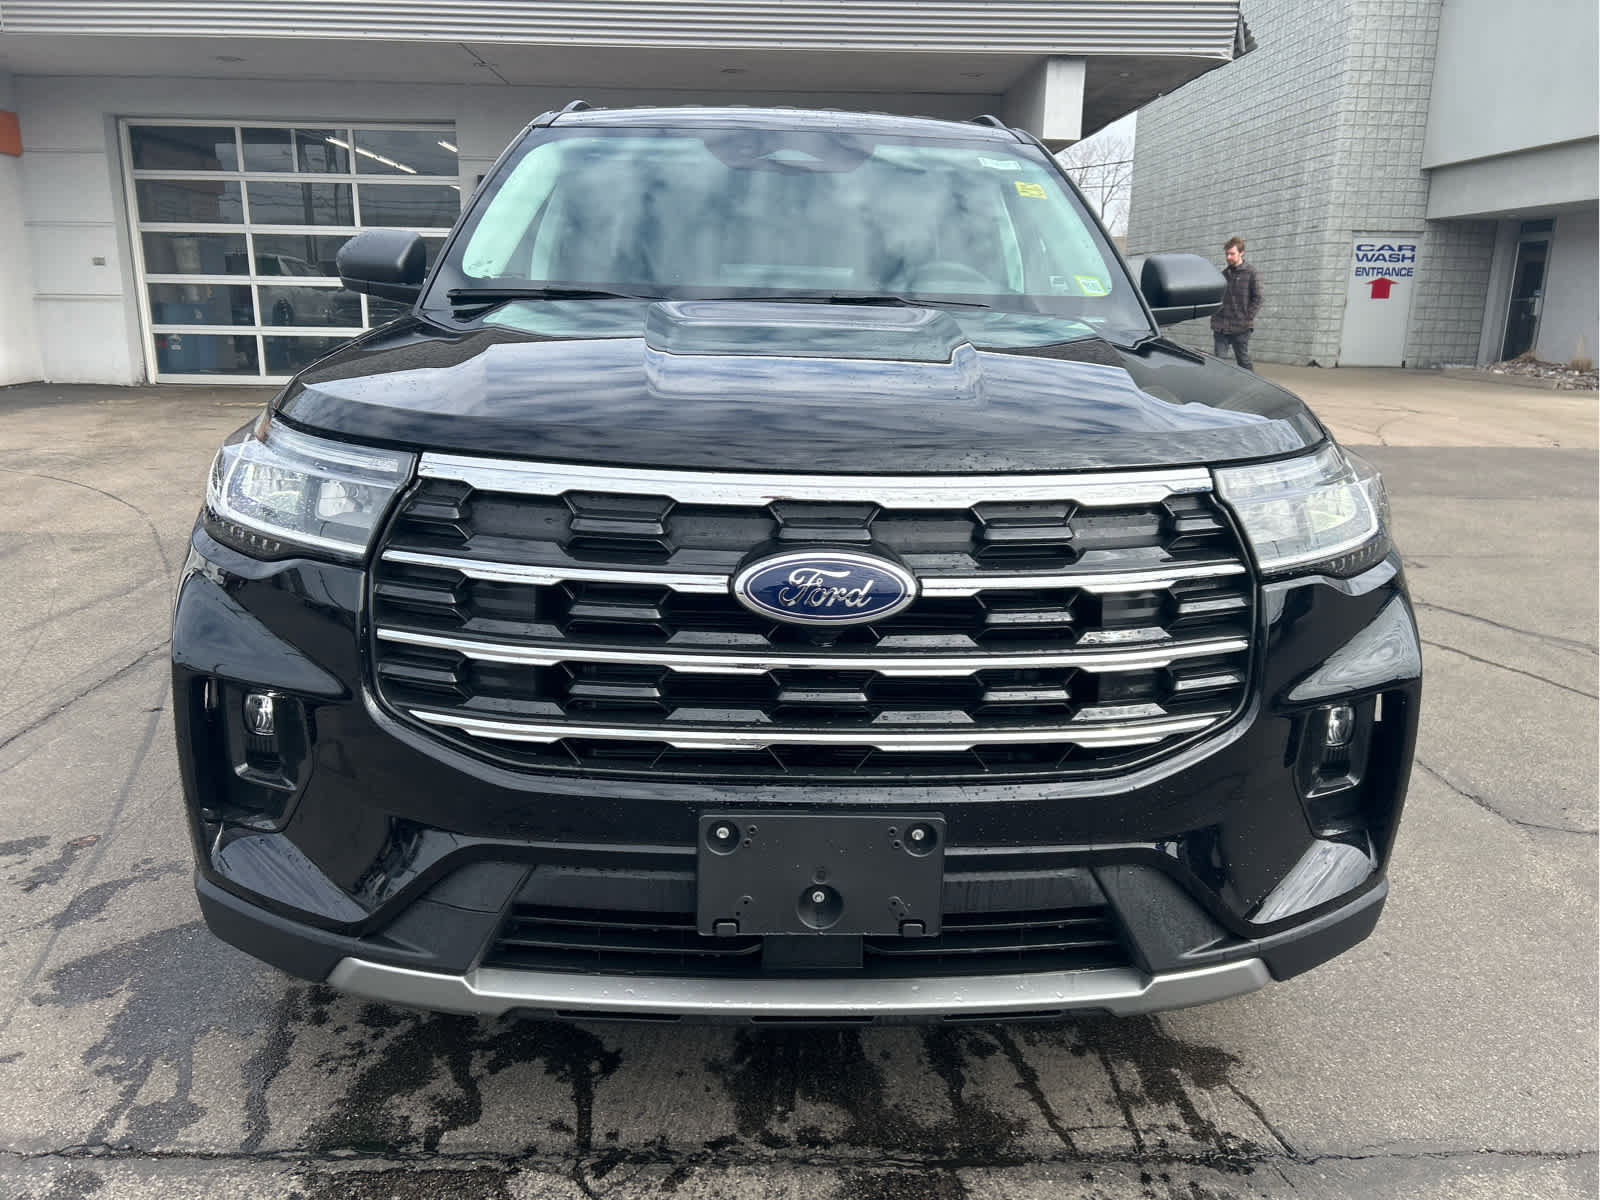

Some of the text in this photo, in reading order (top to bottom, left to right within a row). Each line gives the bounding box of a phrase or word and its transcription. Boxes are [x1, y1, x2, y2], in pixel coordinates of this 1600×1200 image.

[1356, 244, 1416, 252] CAR
[1355, 253, 1415, 263] WASH
[1354, 266, 1414, 277] ENTRANCE
[778, 567, 875, 608] Ford
